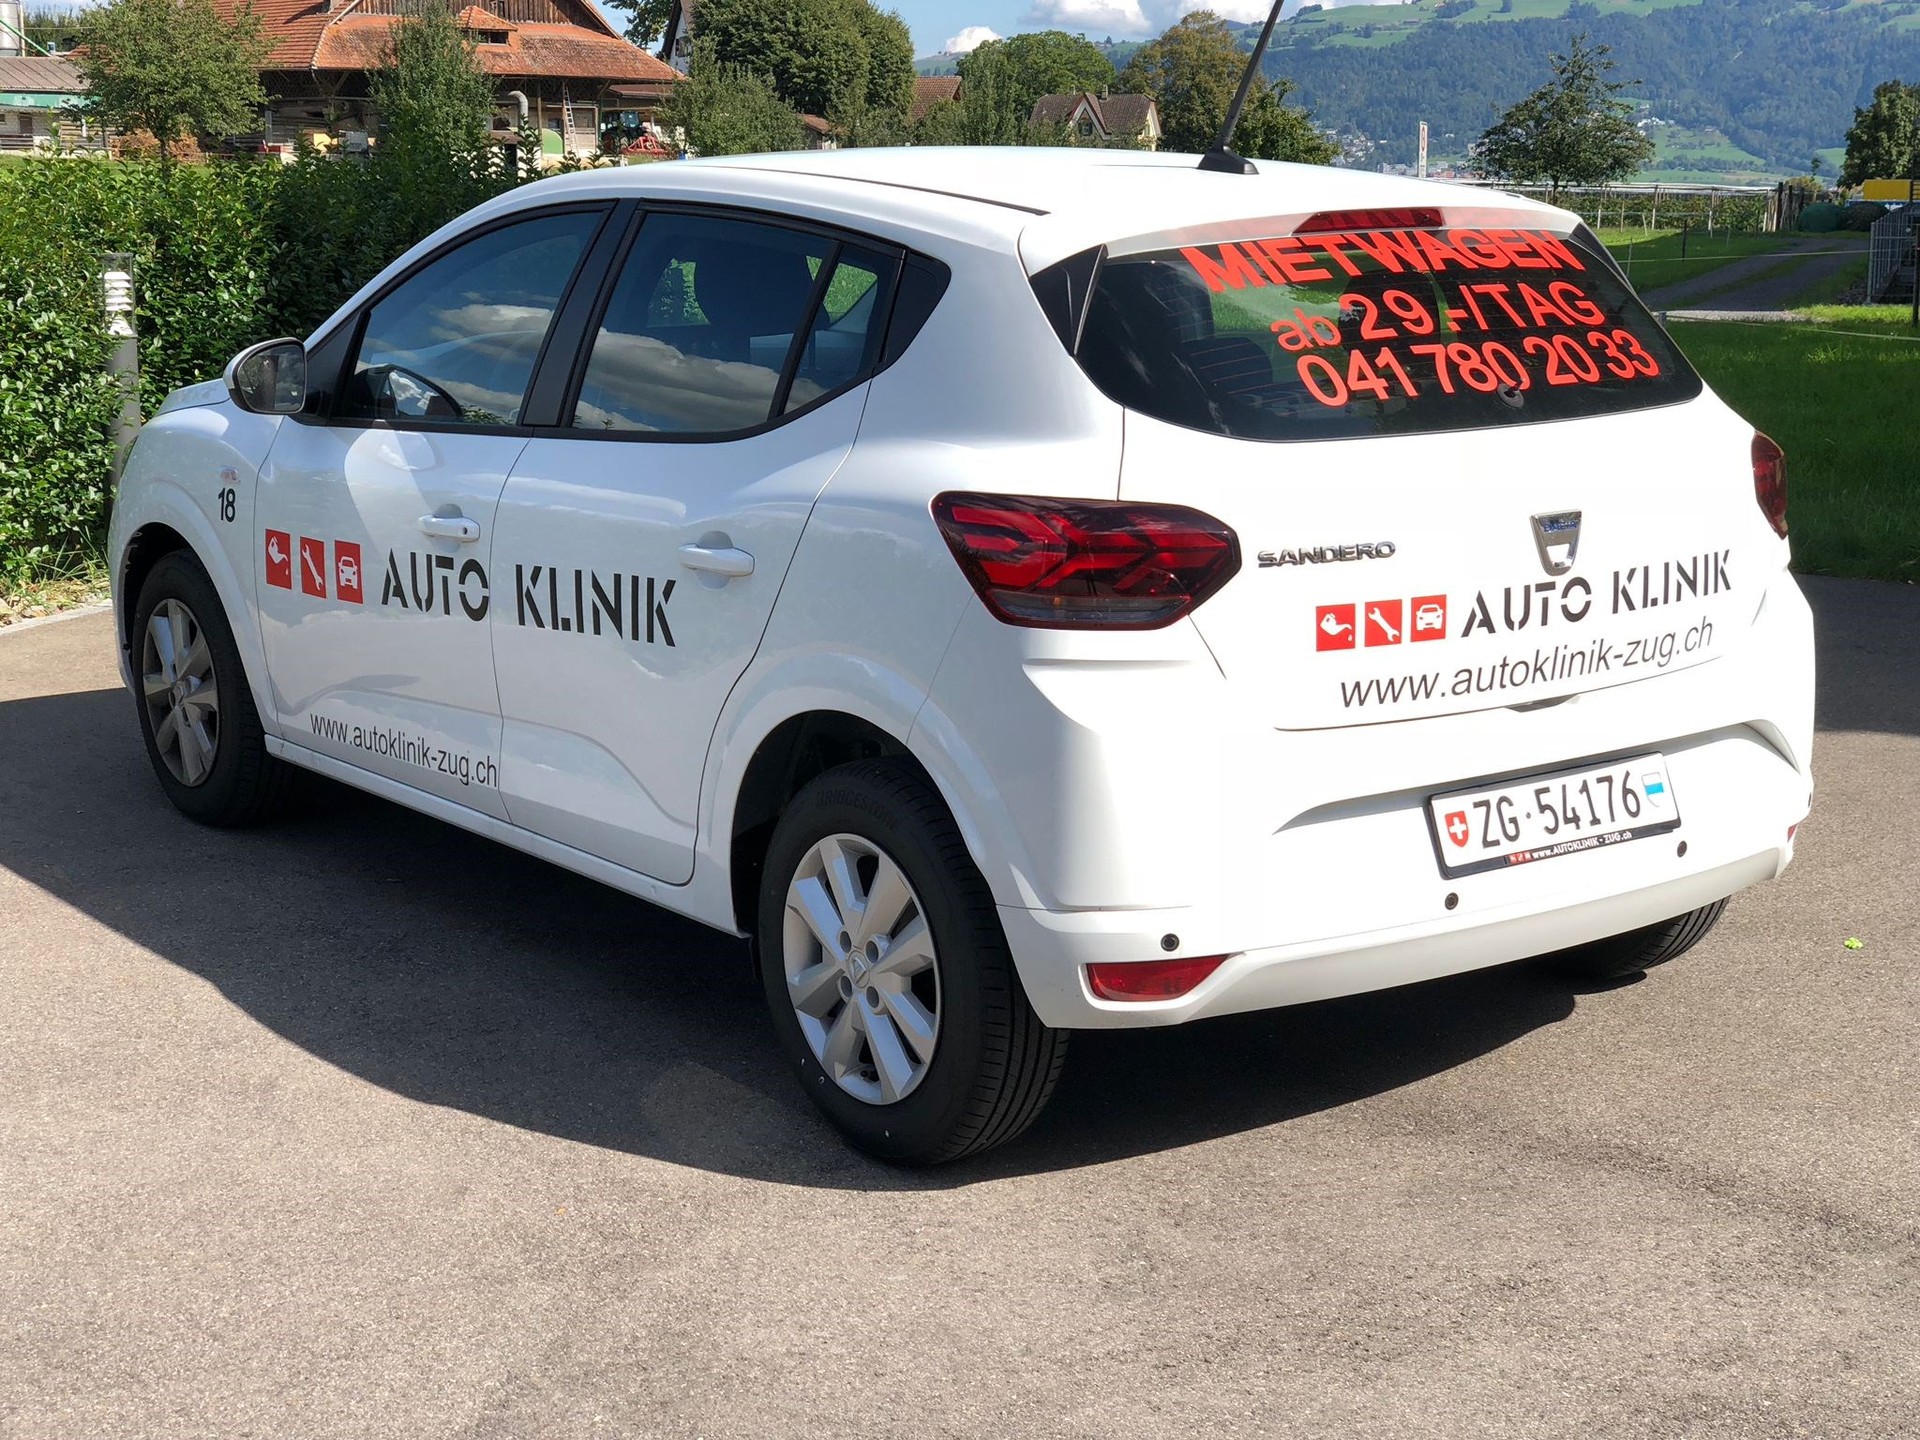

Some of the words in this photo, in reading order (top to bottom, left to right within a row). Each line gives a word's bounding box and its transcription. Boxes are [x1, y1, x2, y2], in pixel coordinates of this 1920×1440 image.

[1179, 229, 1585, 293] MIETWAGEN
[1271, 308, 1341, 350] ab
[1296, 346, 1419, 407] 041
[1409, 341, 1531, 394] 780
[1523, 333, 1600, 386] 20
[1587, 328, 1660, 379] 33
[218, 487, 236, 523] 18
[1257, 541, 1396, 569] SANDERO
[381, 547, 490, 622] AUTO
[515, 563, 677, 647] KLINIK
[1460, 576, 1592, 638] AUTO
[1611, 549, 1733, 614] KLINIK
[1340, 615, 1714, 708] www.autoklinik-zug.ch
[310, 713, 498, 788] www.autoklinik-zug.ch
